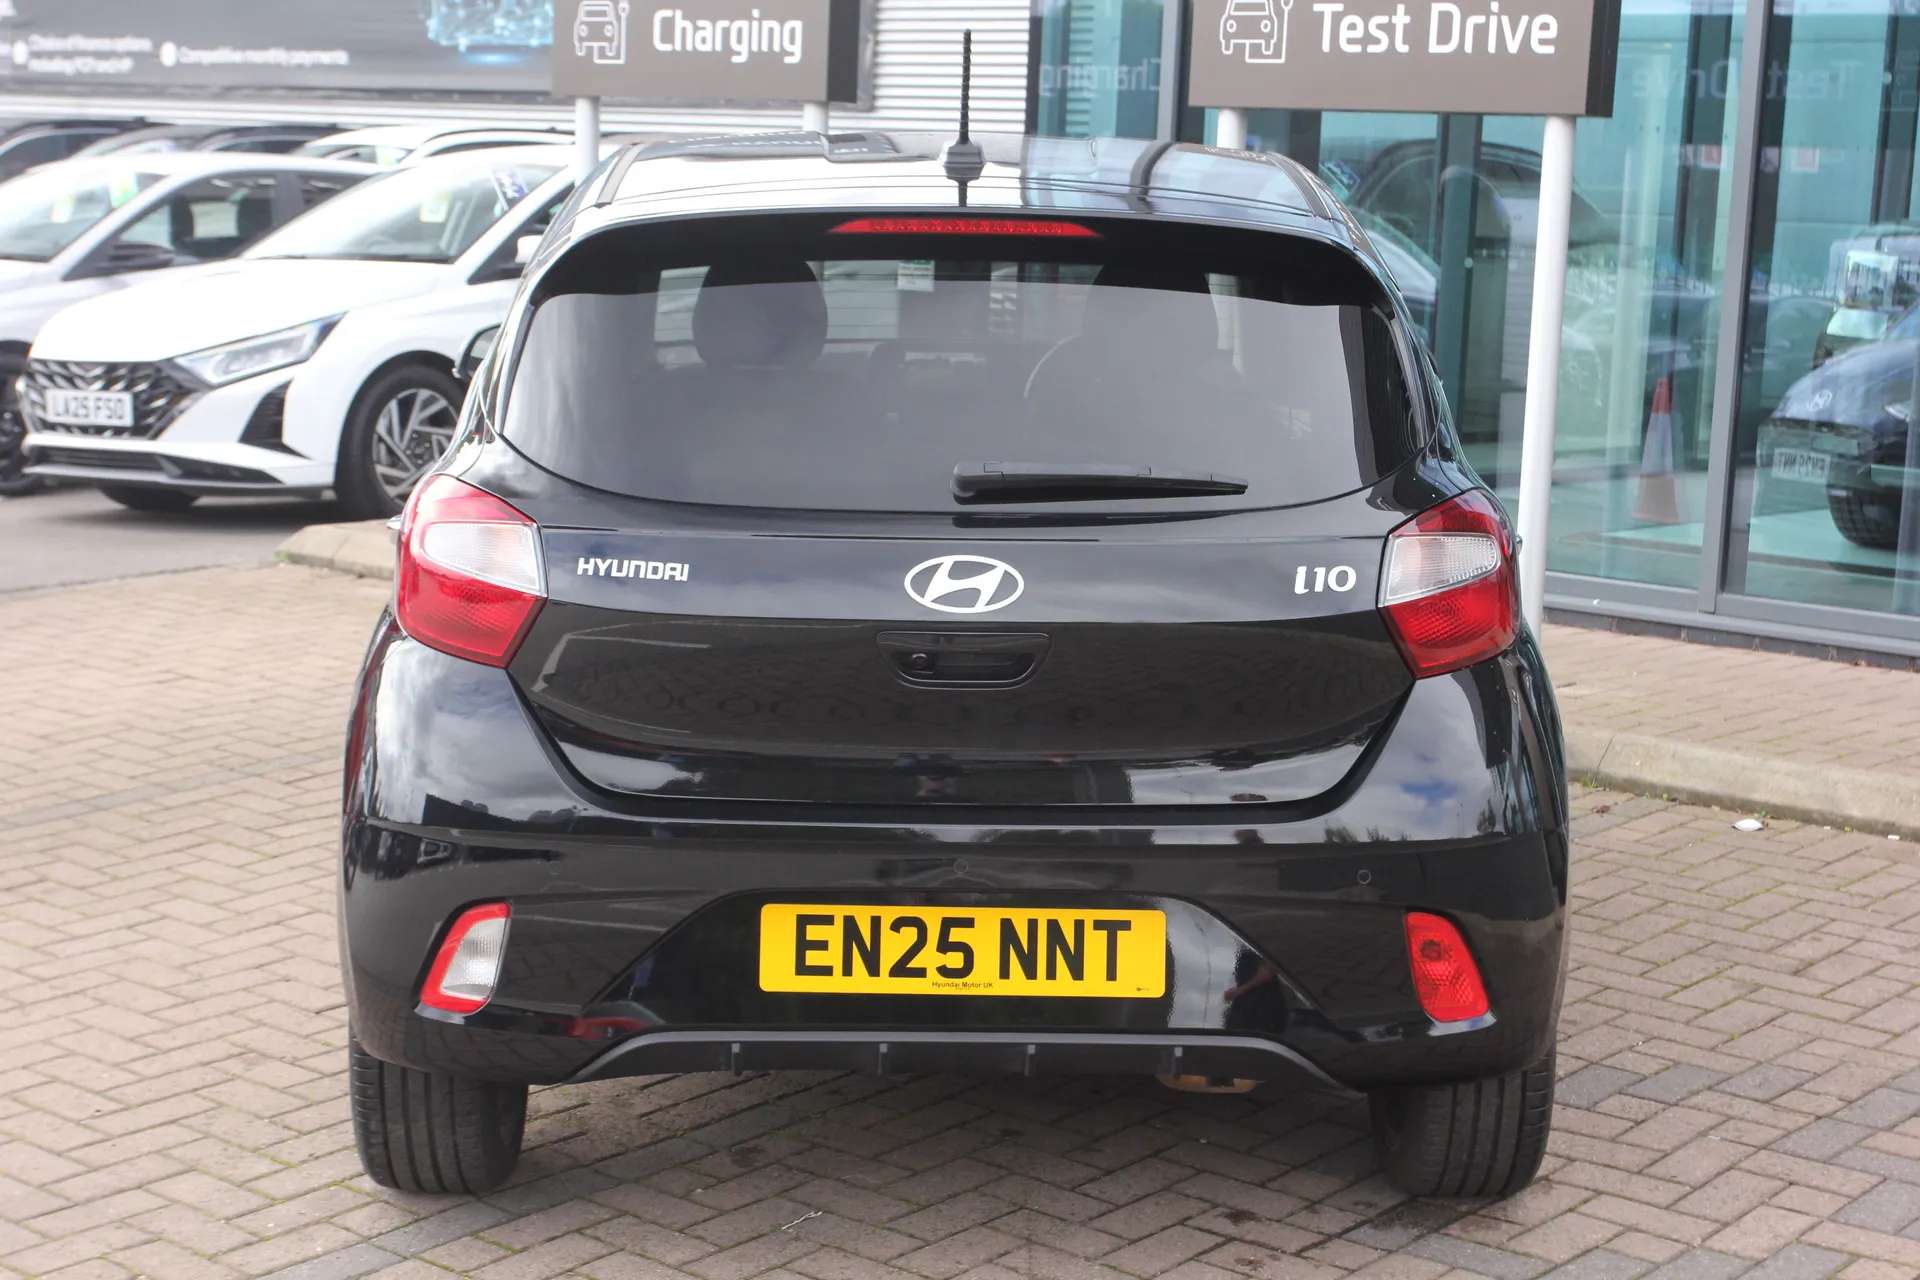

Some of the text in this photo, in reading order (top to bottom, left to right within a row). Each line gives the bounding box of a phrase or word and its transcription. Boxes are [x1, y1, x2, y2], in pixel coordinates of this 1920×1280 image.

[652, 9, 803, 64] Charging
[1313, 1, 1558, 54] Test Drive
[577, 557, 690, 582] HYUNDAI
[795, 914, 1131, 982] EN25 NNT
